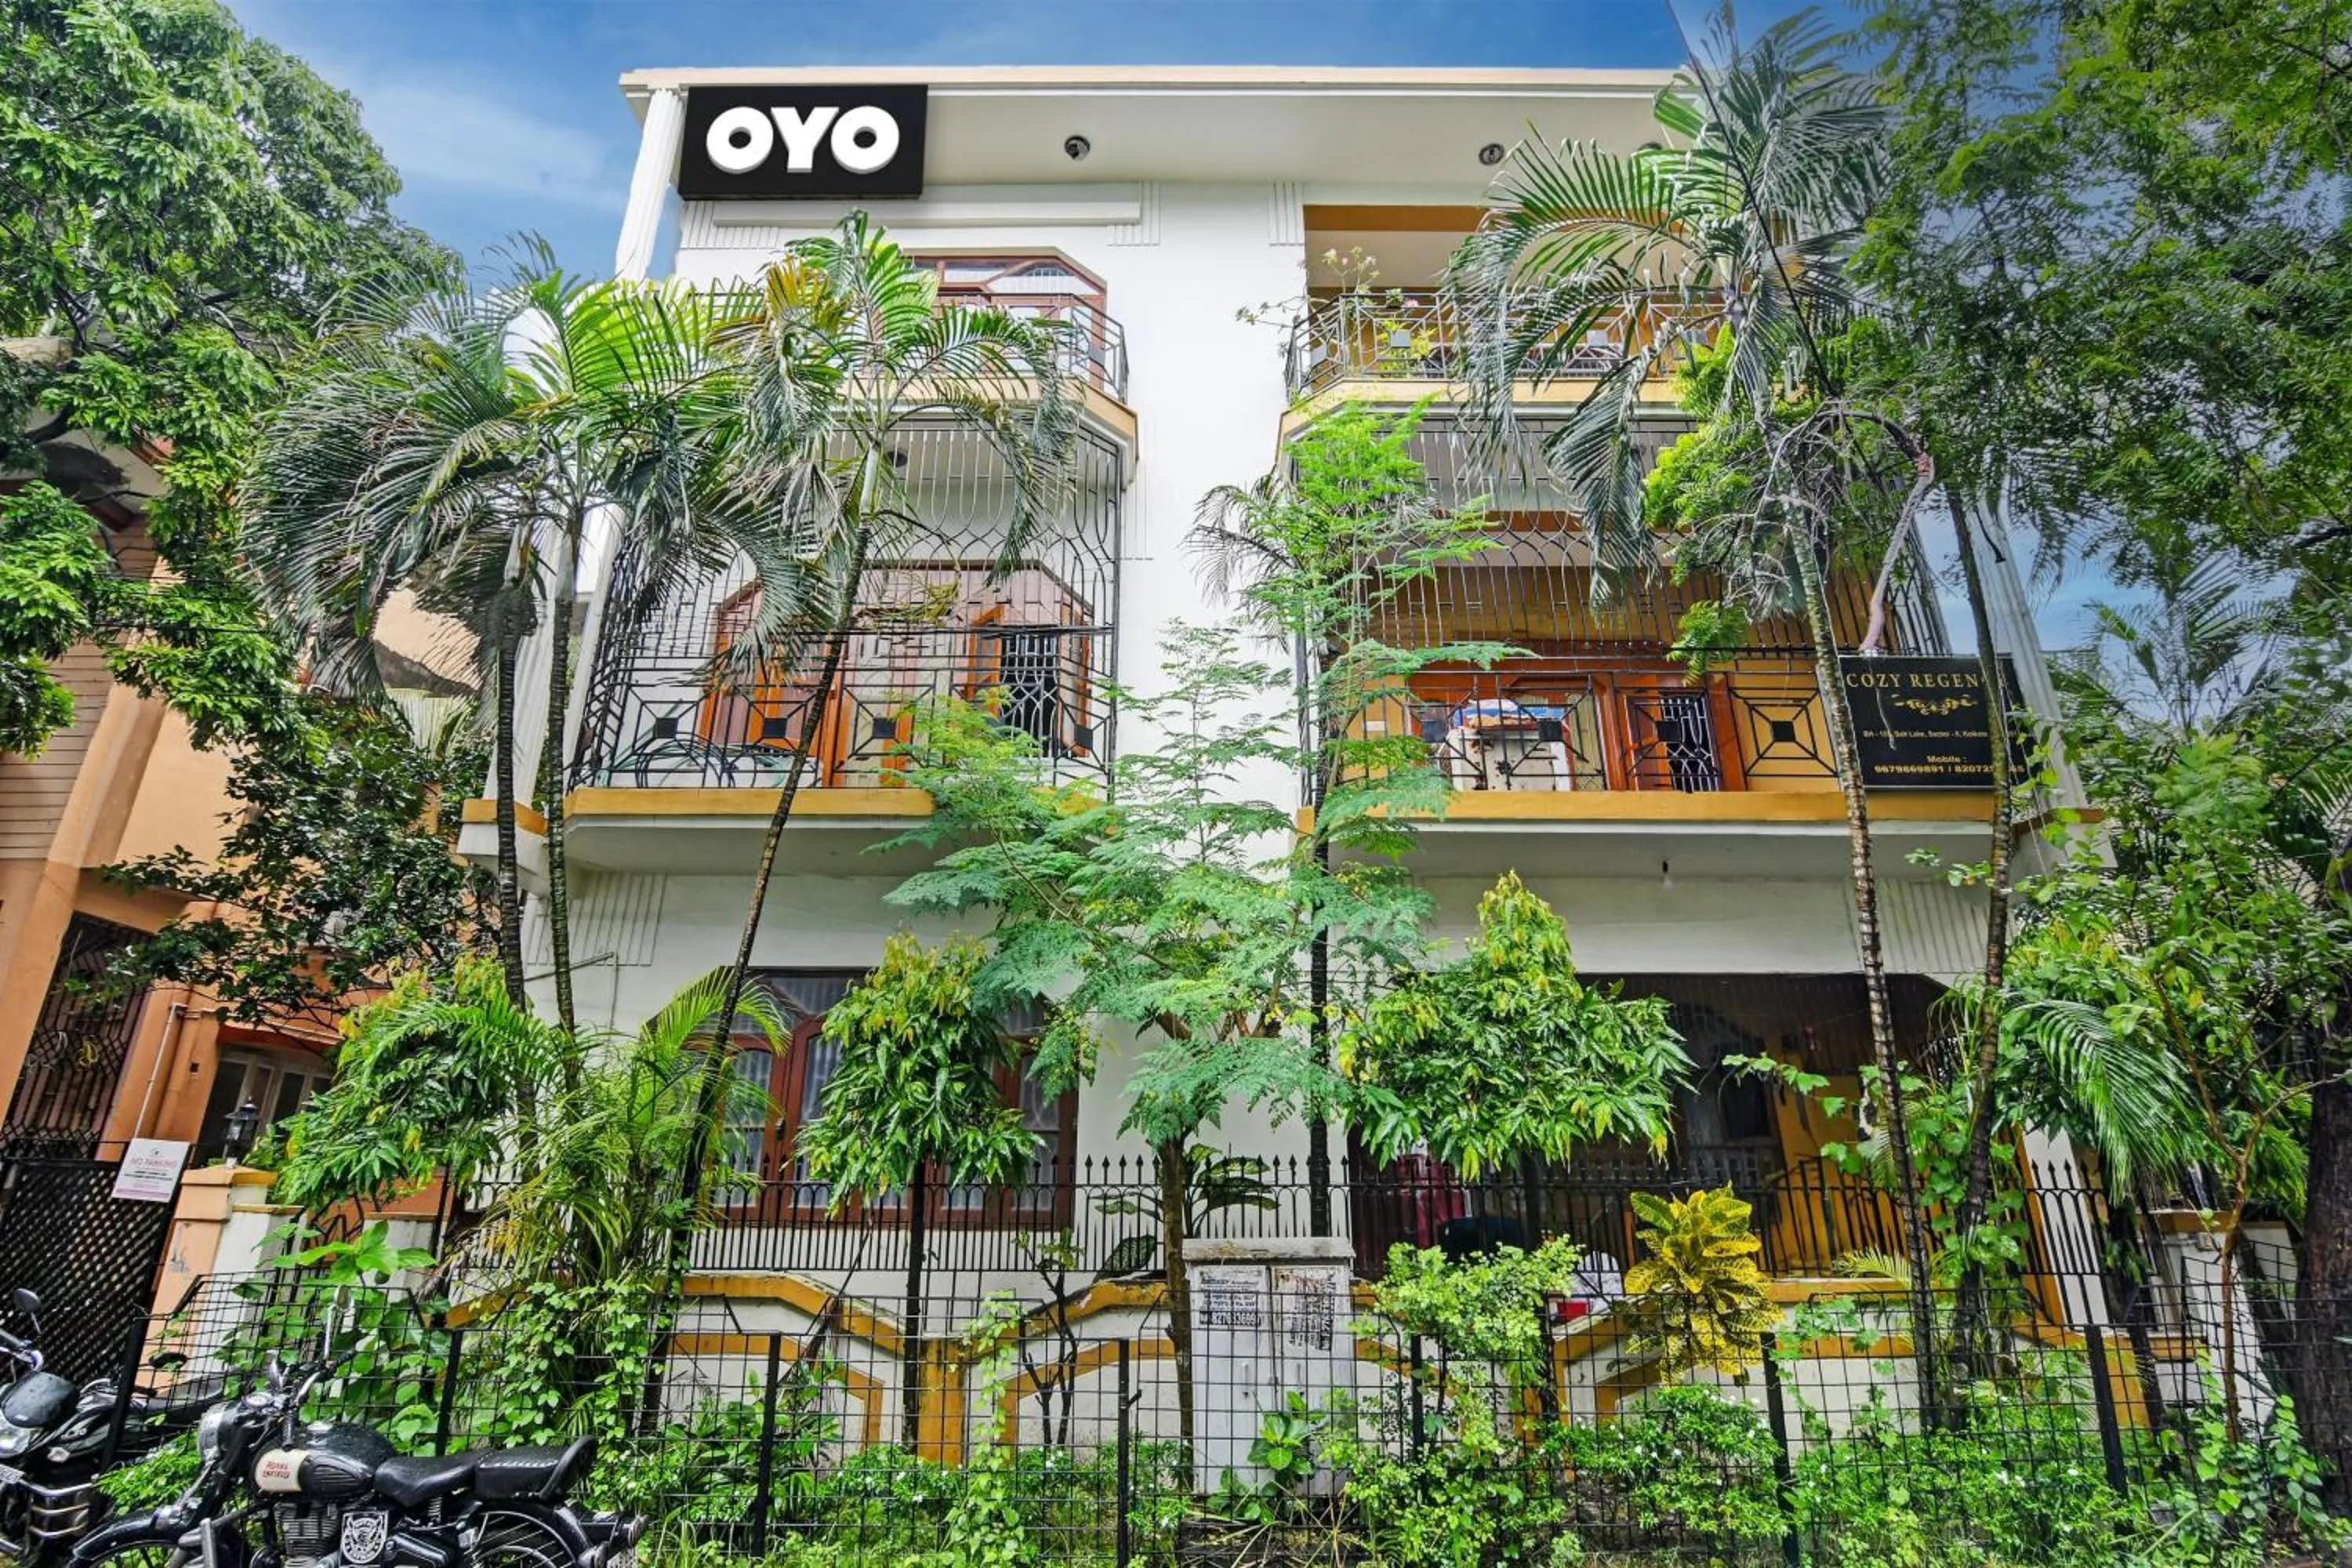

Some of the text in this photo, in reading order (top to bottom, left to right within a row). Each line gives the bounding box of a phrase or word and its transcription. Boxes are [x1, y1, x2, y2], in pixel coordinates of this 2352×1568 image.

[706, 106, 900, 174] OYO
[1846, 673, 1986, 688] COZY REGEN
